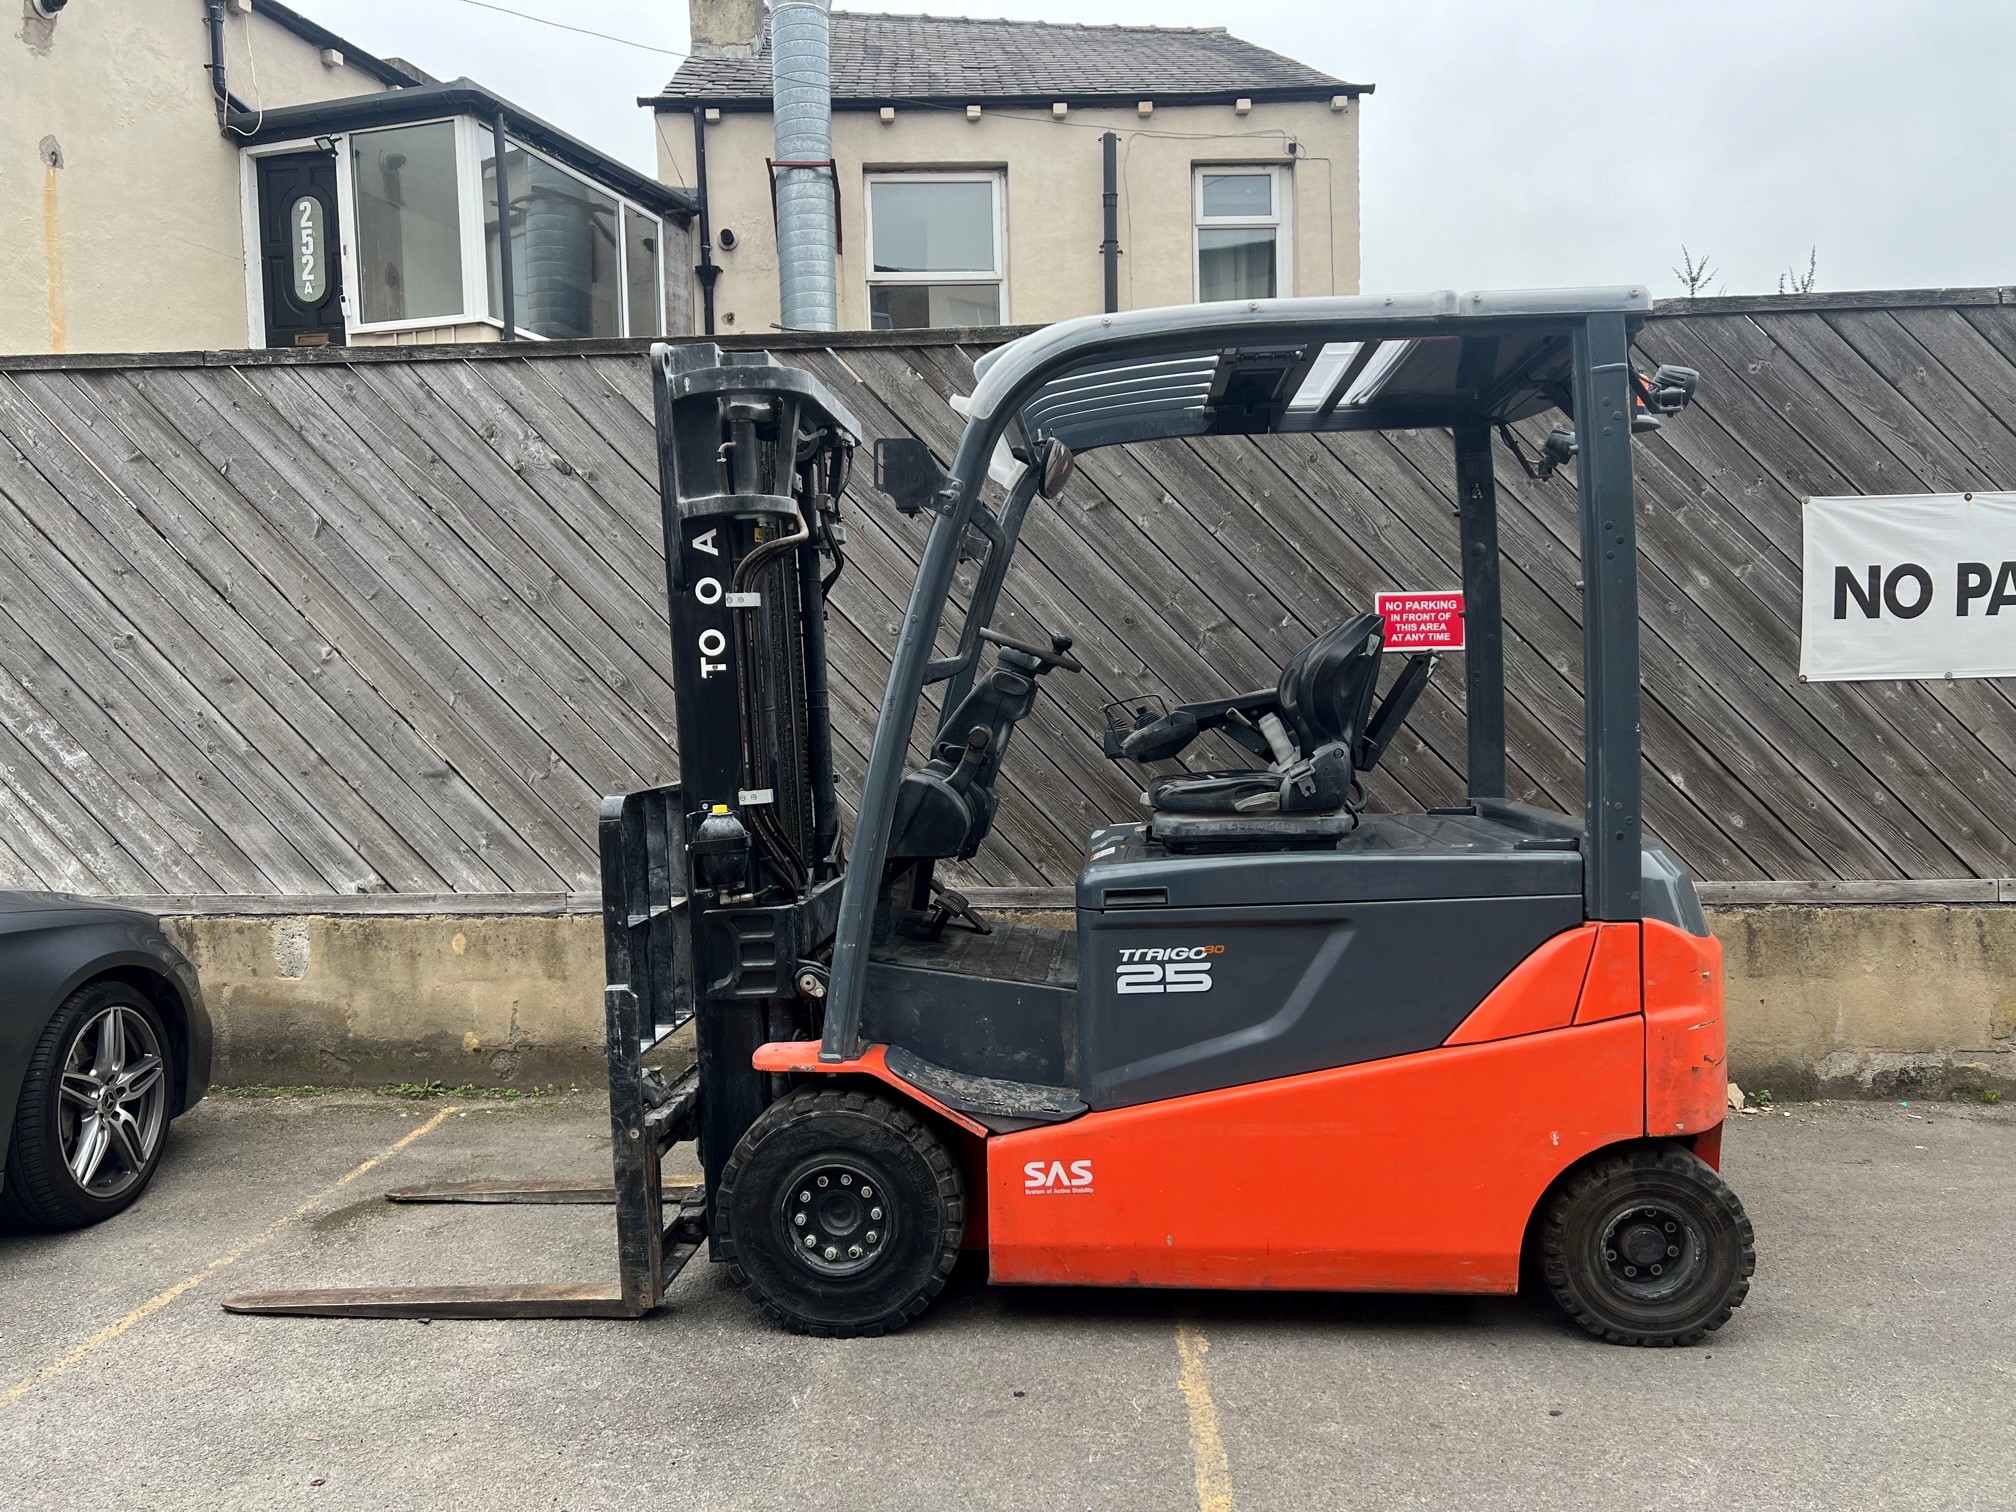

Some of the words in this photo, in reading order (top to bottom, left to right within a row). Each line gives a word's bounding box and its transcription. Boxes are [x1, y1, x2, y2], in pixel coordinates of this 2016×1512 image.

[1833, 562, 1934, 620] NO
[1385, 601, 1403, 611] NO
[1405, 600, 1457, 611] PARKING
[1390, 613, 1400, 622] IN
[1402, 612, 1436, 621] FRONT
[1437, 612, 1452, 621] OF
[1395, 623, 1417, 632] THIS
[1419, 622, 1447, 631] AREA
[1391, 633, 1404, 642] AT
[1404, 633, 1425, 642] ANY
[1427, 632, 1451, 641] TIME
[1119, 946, 1207, 962] TRAIGO
[1116, 962, 1213, 994] 25
[1024, 1160, 1093, 1187] SAS
[1025, 1188, 1045, 1196] System
[1072, 1186, 1094, 1194] Stability
